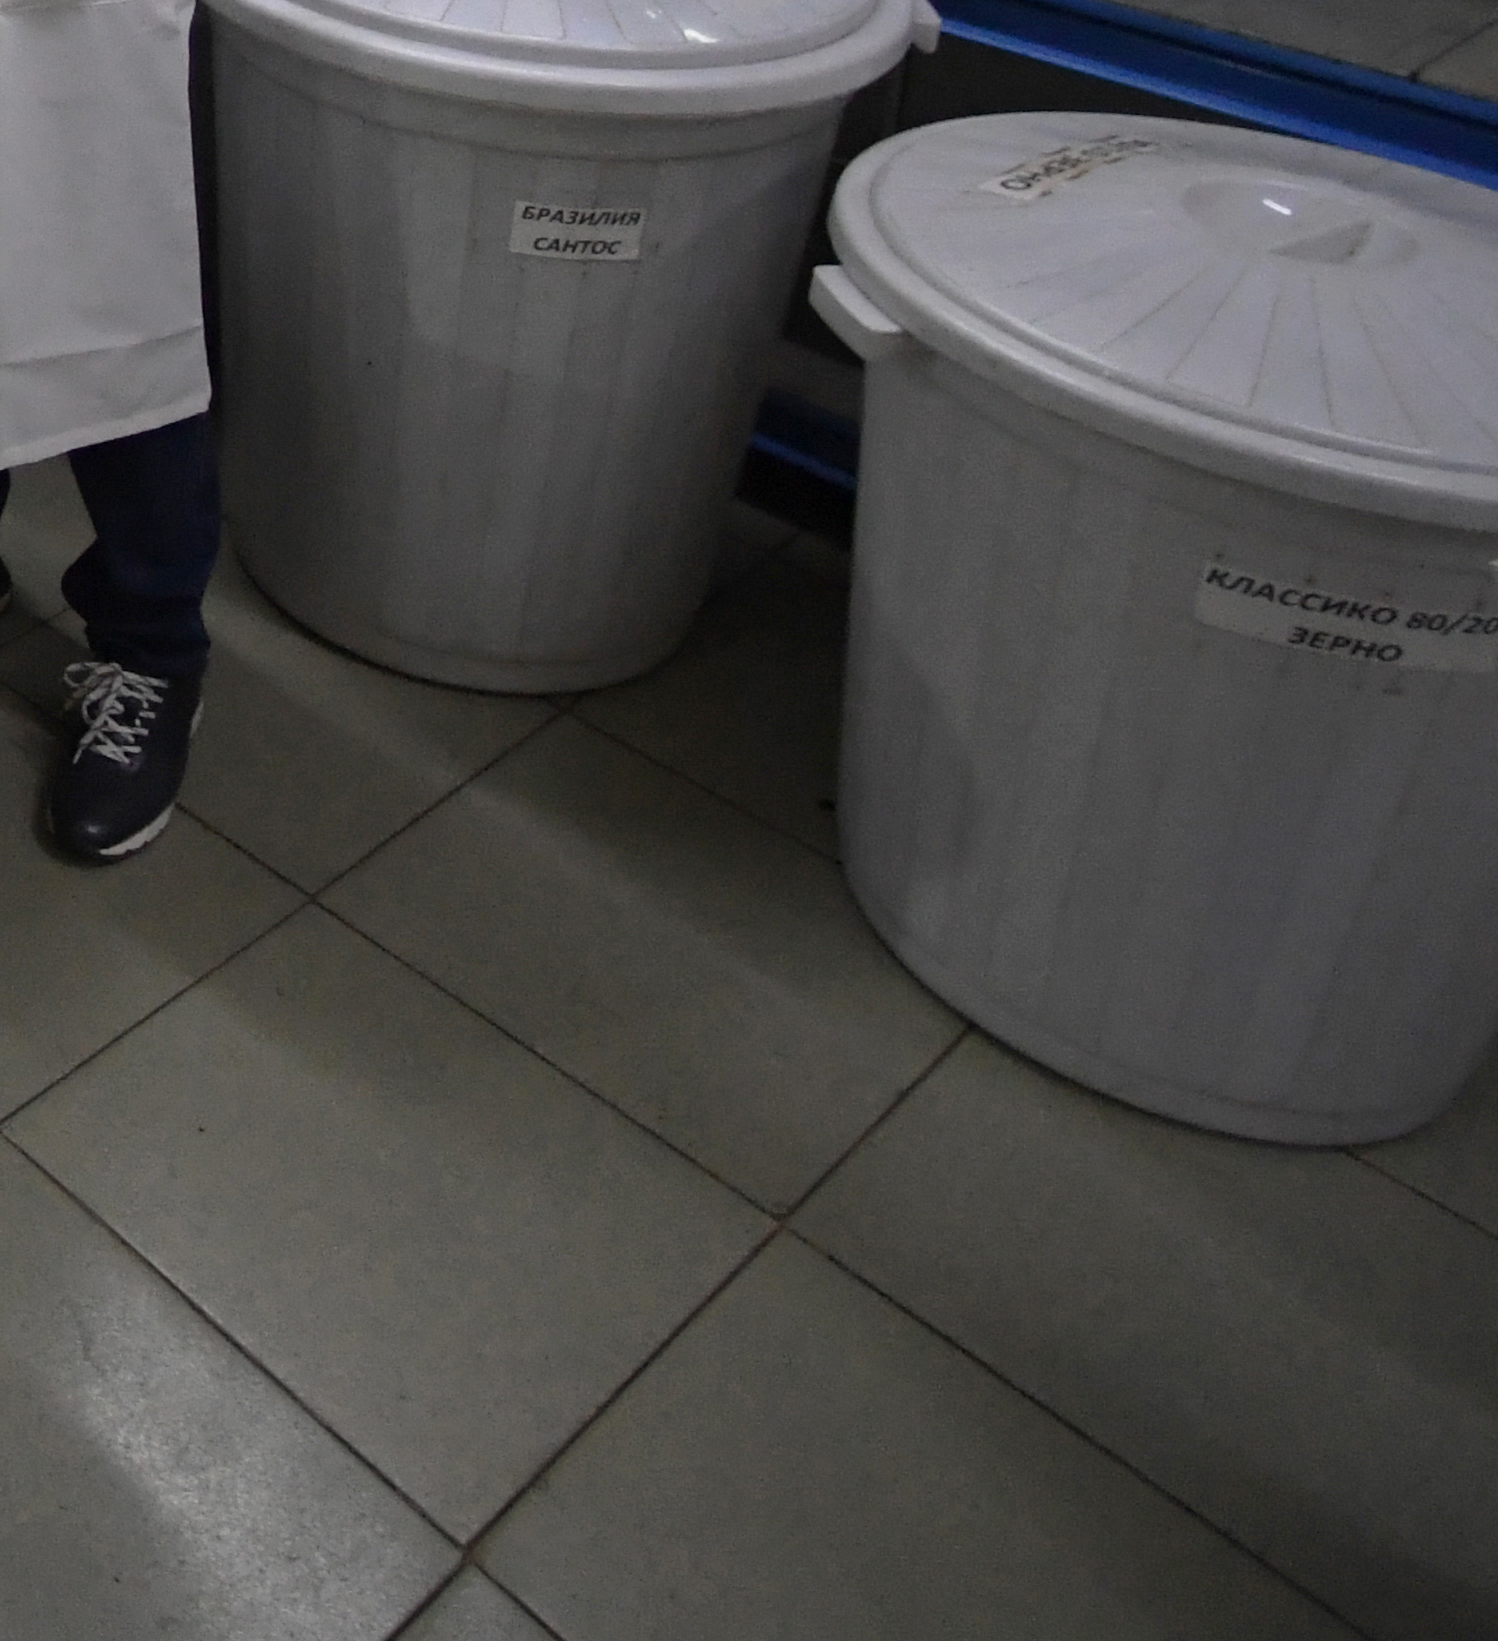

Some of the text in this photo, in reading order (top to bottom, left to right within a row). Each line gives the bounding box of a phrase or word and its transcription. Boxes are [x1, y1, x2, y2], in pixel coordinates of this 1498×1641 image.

[521, 205, 641, 227] БРАЗИЛИЯ
[533, 237, 623, 256] САНТОС
[1206, 567, 1398, 626] КЛАССИКО
[1288, 626, 1403, 662] ЗЕРНО
